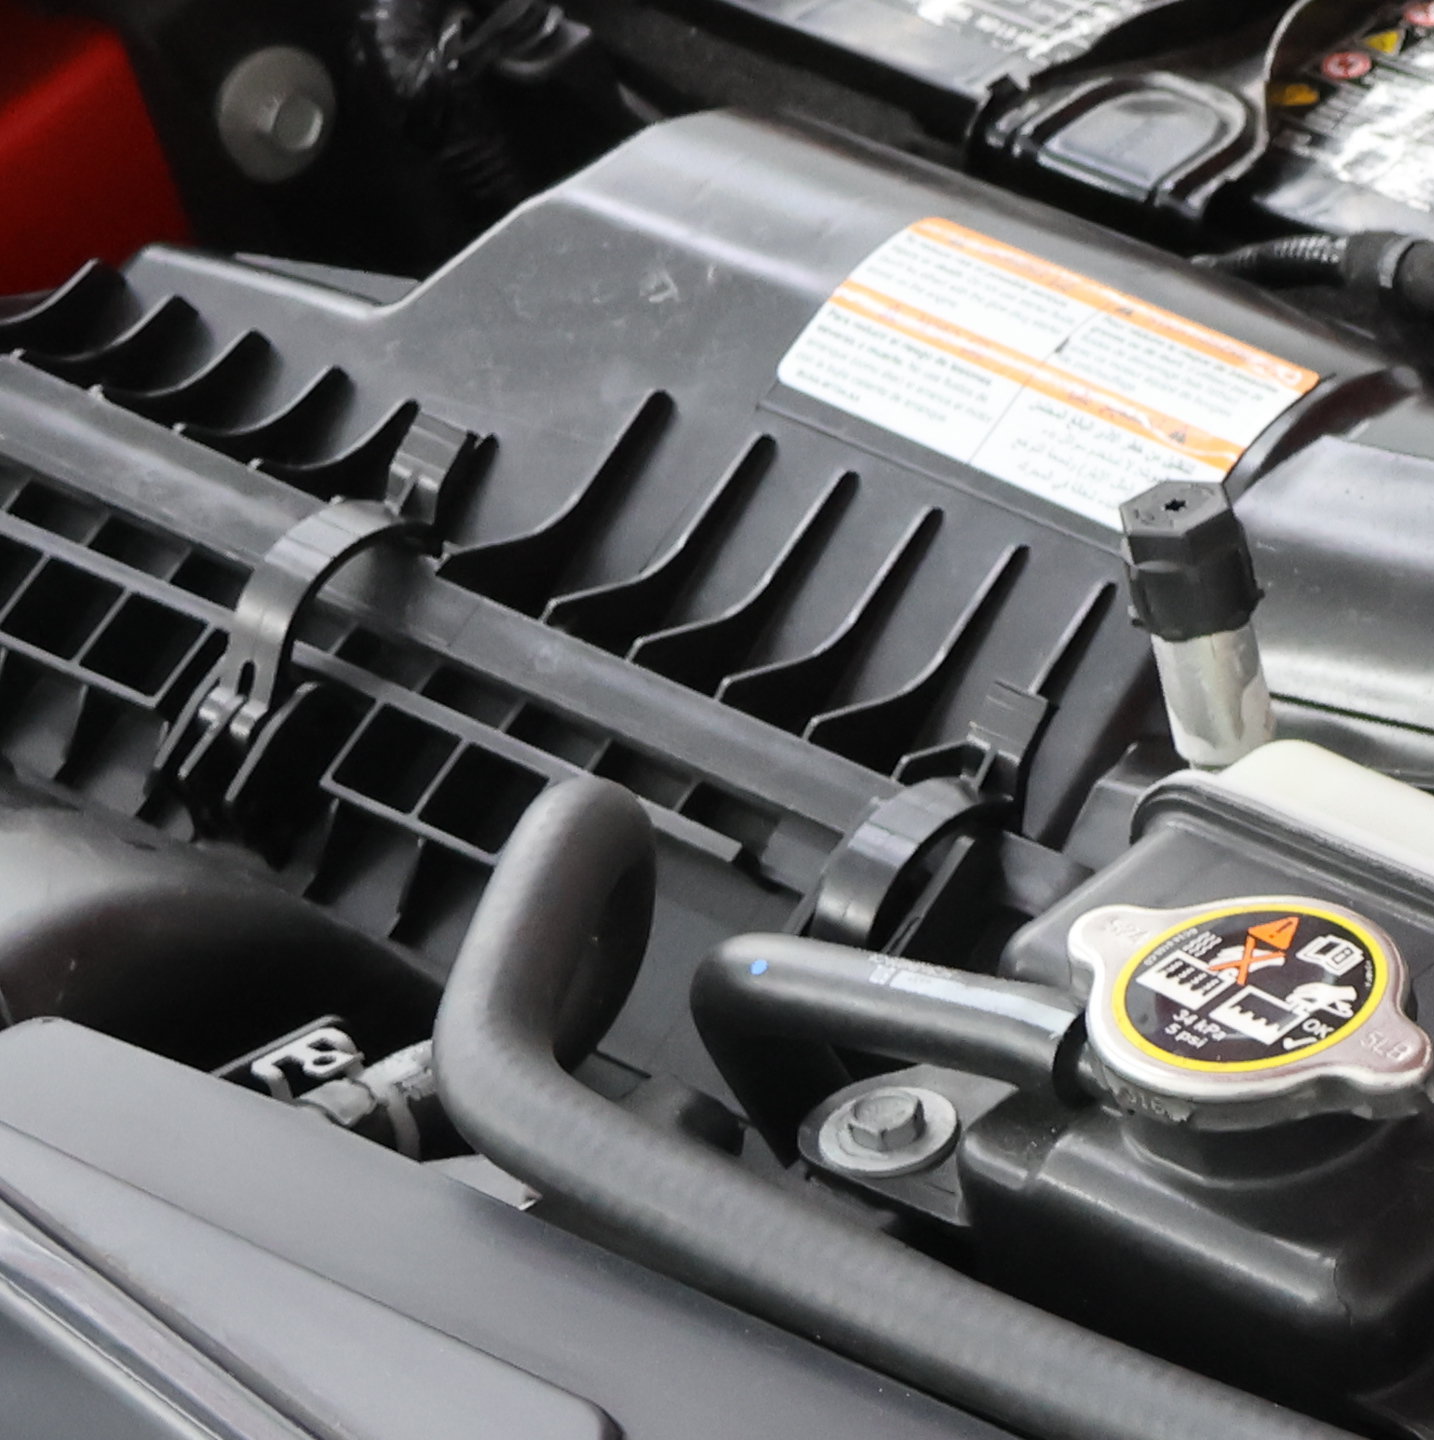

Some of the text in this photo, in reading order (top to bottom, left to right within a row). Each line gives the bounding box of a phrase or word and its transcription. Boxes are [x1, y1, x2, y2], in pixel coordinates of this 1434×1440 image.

[1164, 1022, 1209, 1049] 5 psi
[1173, 1008, 1227, 1042] 34 kPa
[1302, 1018, 1335, 1039] OK
